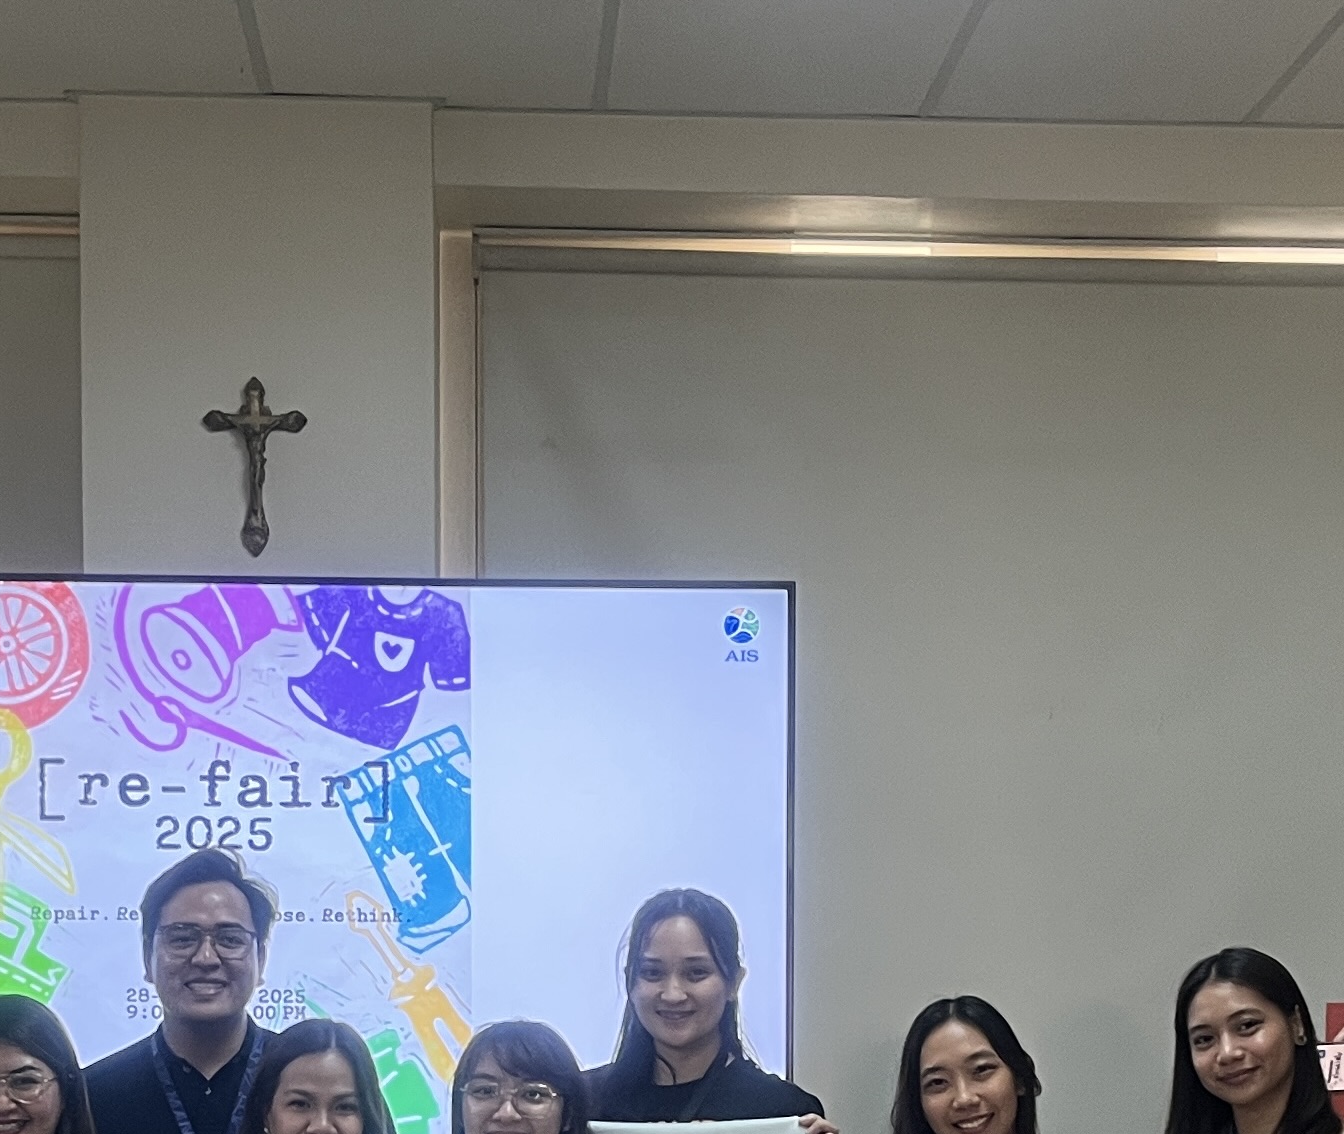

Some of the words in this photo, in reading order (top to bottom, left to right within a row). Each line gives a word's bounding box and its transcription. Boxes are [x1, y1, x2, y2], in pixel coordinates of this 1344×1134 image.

[725, 649, 759, 662] AIS
[156, 815, 273, 851] 2025
[30, 906, 108, 924] Repair.
[321, 908, 412, 923] Rethink.
[259, 988, 306, 1003] 2025
[283, 1006, 306, 1020] PM
